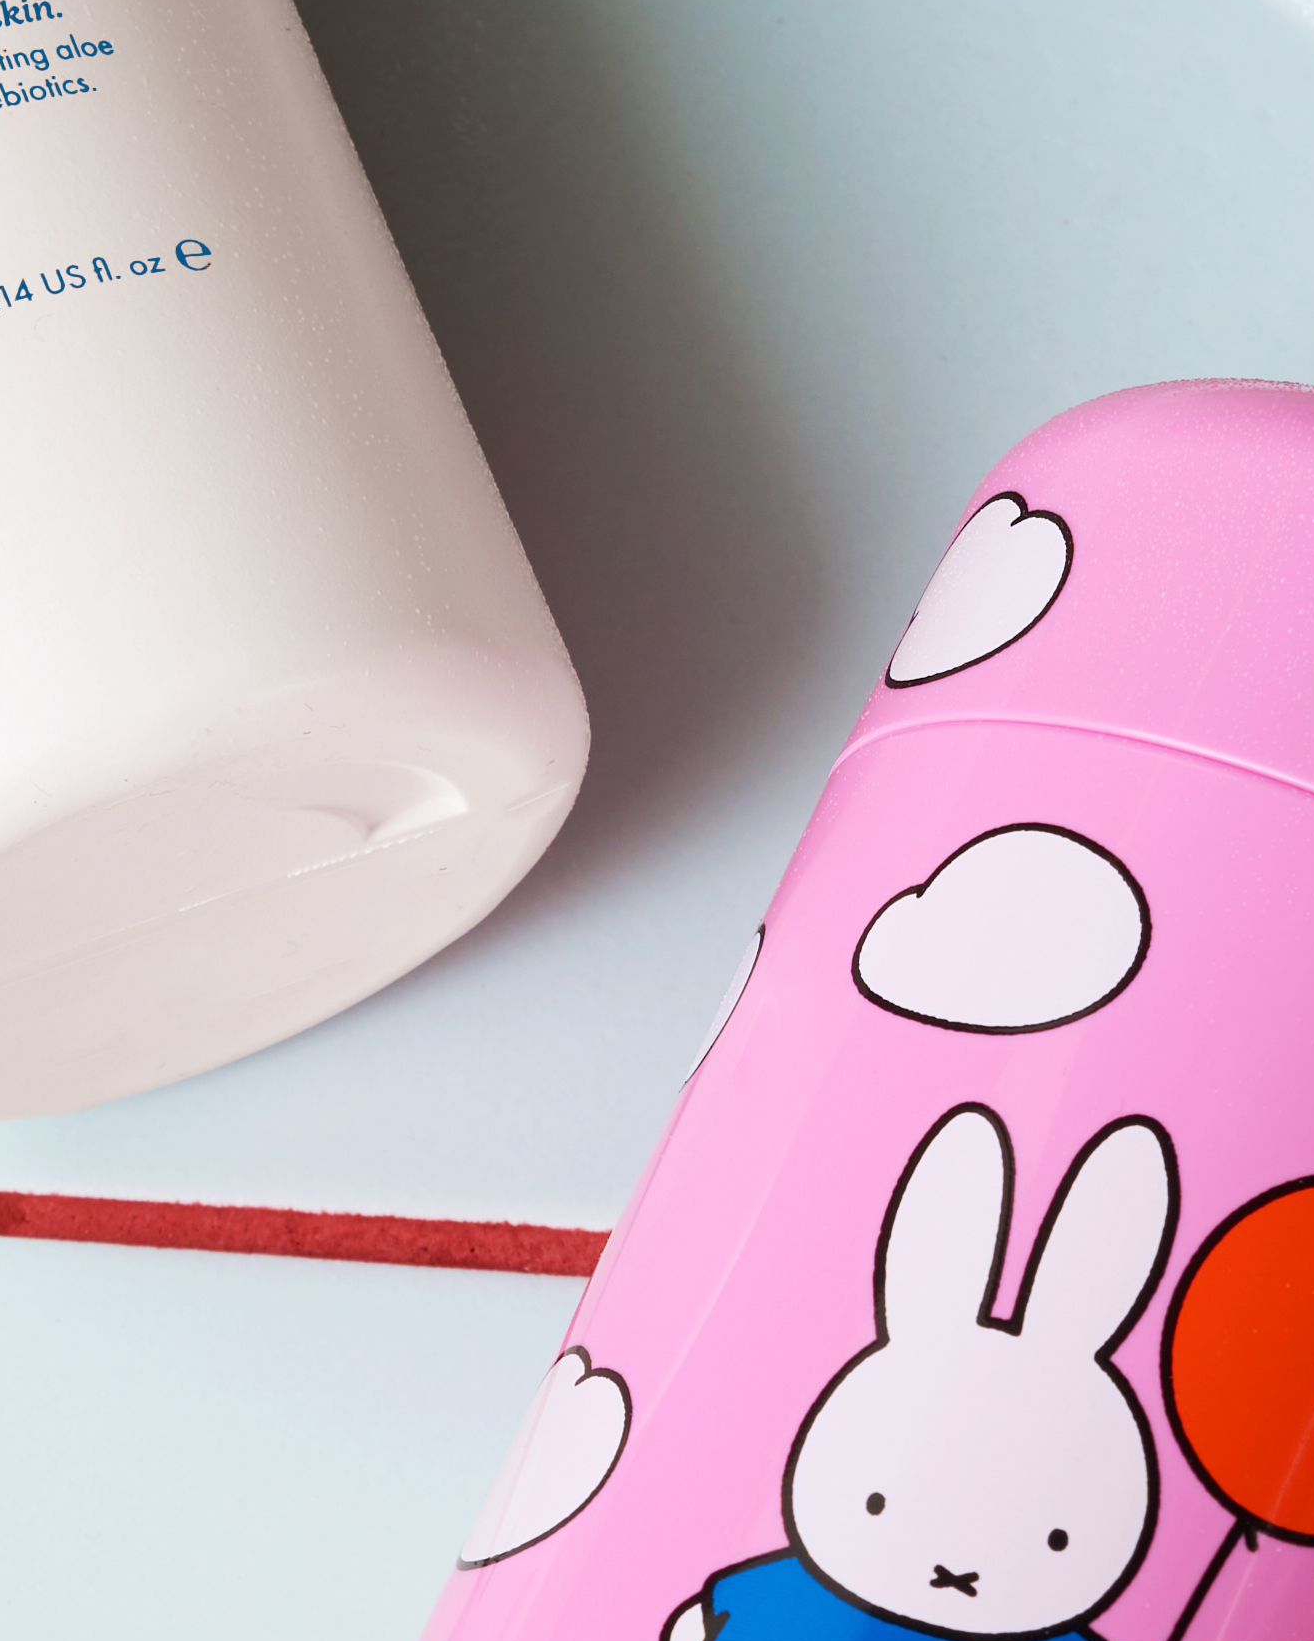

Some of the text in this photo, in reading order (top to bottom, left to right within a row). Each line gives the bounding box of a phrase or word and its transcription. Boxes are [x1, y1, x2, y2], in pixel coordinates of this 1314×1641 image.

[56, 34, 114, 60] aloe
[40, 265, 86, 295] US
[93, 257, 121, 282] fl.
[129, 257, 165, 276] oz
